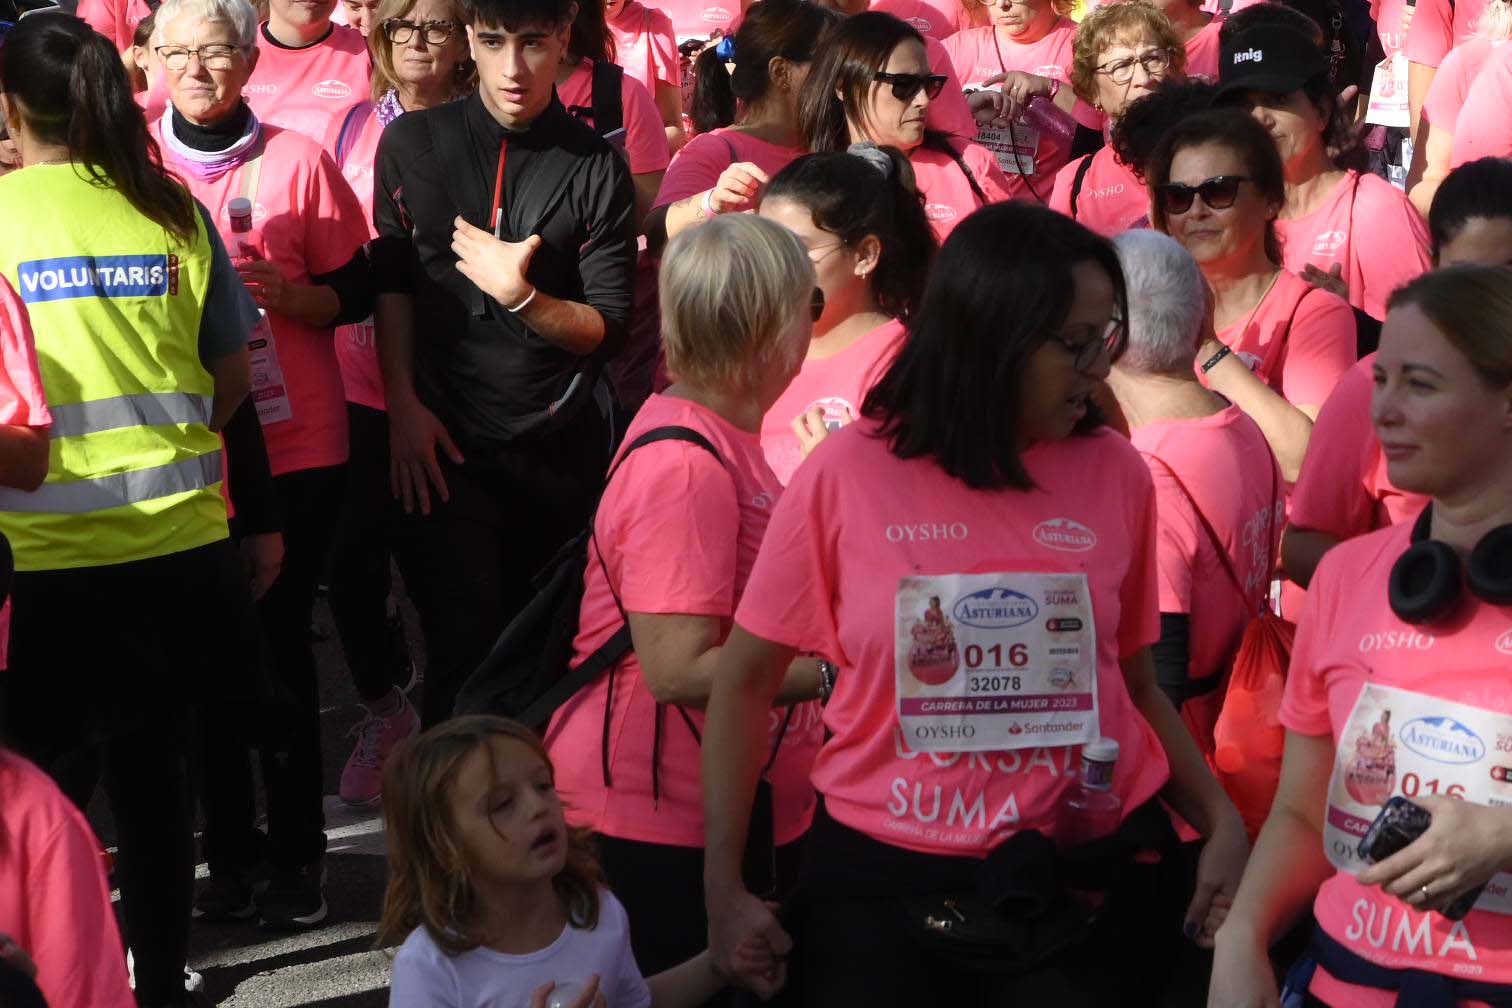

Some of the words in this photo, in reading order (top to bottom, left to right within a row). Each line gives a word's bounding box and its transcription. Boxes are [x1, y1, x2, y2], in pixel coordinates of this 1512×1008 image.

[1233, 48, 1263, 65] itnig
[22, 266, 164, 292] VOLUNTARIS
[885, 522, 968, 542] OYSHO
[1038, 528, 1096, 547] ASTURIANA
[961, 604, 1032, 619] ASTURIANA
[1359, 631, 1436, 652] OYSHO
[964, 643, 1029, 668] 016
[971, 676, 1022, 692] 32078
[921, 700, 974, 712] CARRERA
[976, 699, 992, 710] DE
[994, 699, 1008, 710] LA
[1010, 698, 1048, 710] MUJER
[1052, 697, 1077, 708] 2023
[916, 723, 976, 740] OYSHO
[1024, 721, 1085, 735] Santander
[1406, 726, 1478, 760] ASTURIANA
[888, 777, 1021, 829] SUMA
[1345, 898, 1479, 961] SUMA
